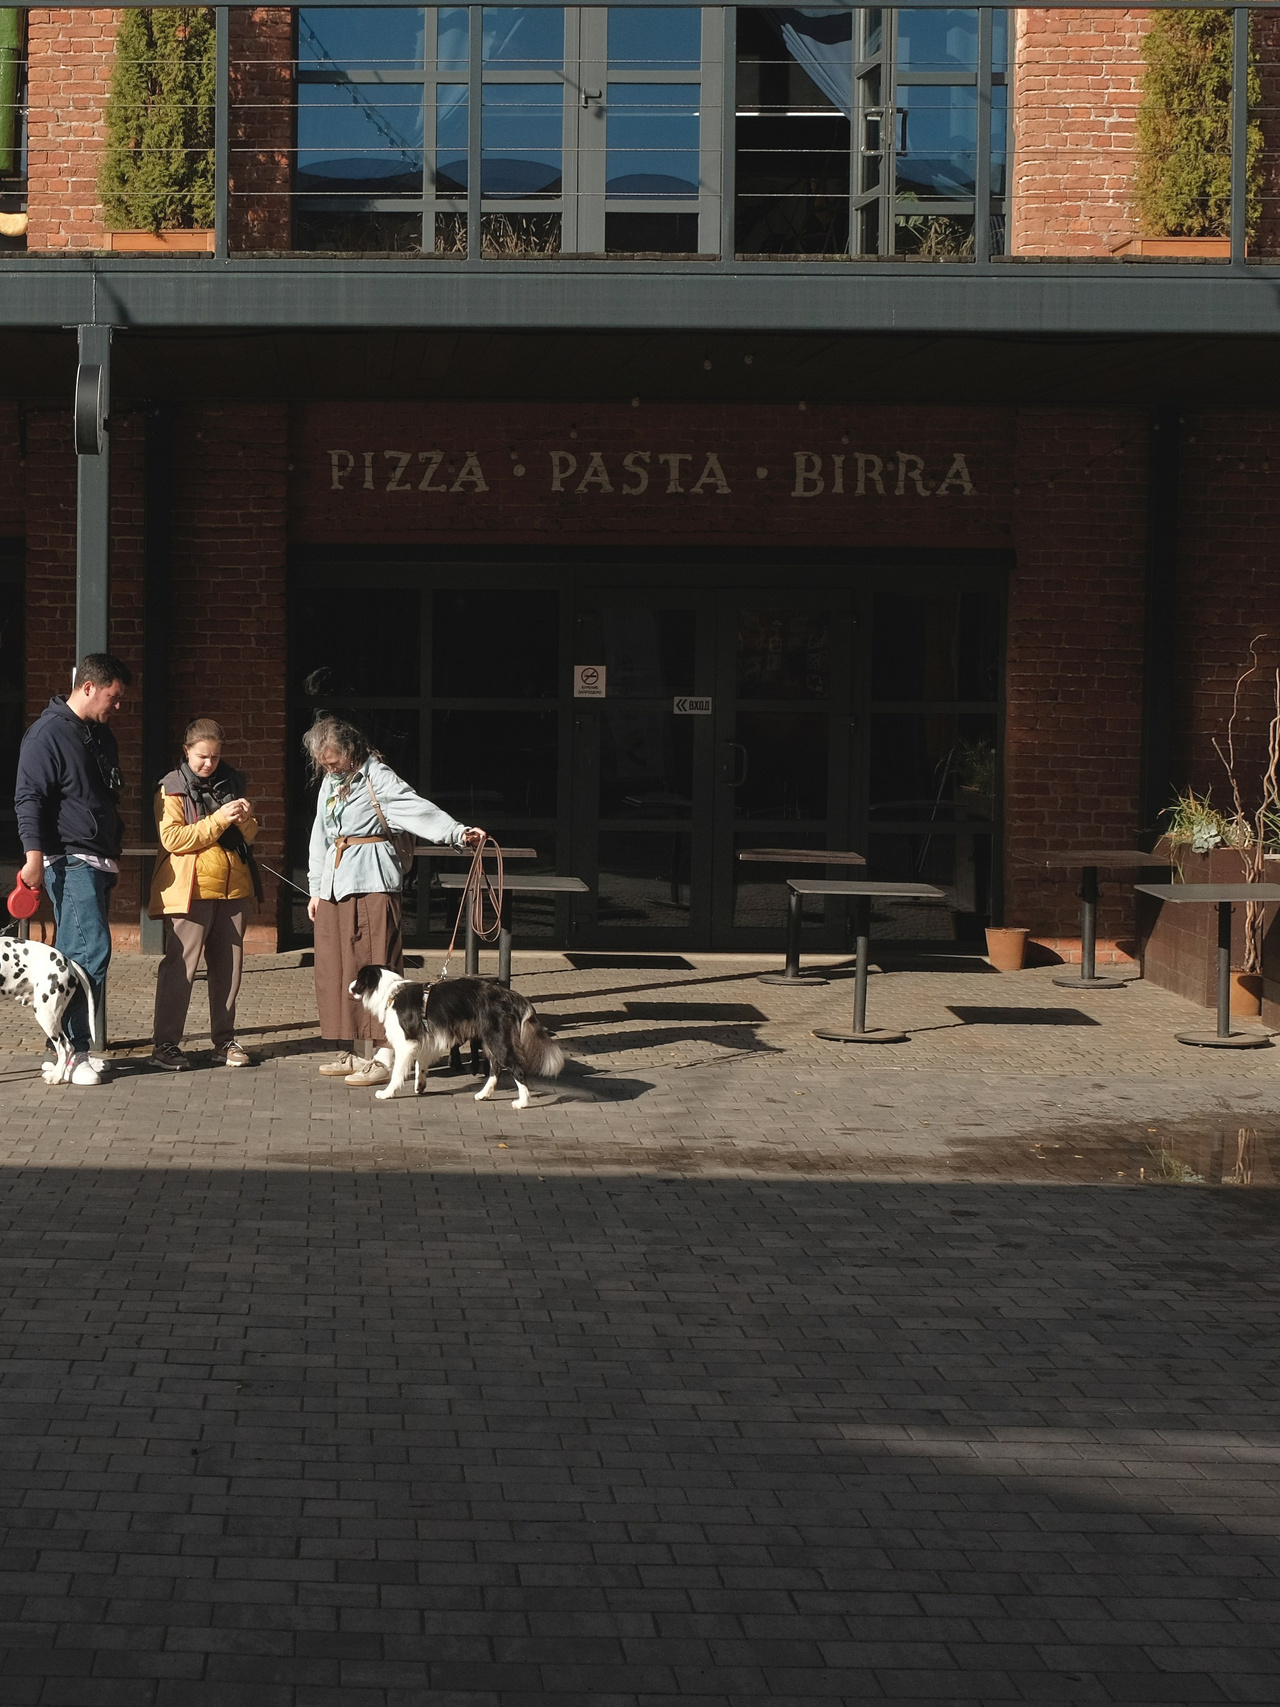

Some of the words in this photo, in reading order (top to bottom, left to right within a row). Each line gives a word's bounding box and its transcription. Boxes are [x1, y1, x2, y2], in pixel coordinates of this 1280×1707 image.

[326, 450, 490, 494] PIZZA
[548, 451, 732, 495] PASTA
[791, 451, 978, 497] BIRRA
[689, 700, 710, 711] ВХОД
